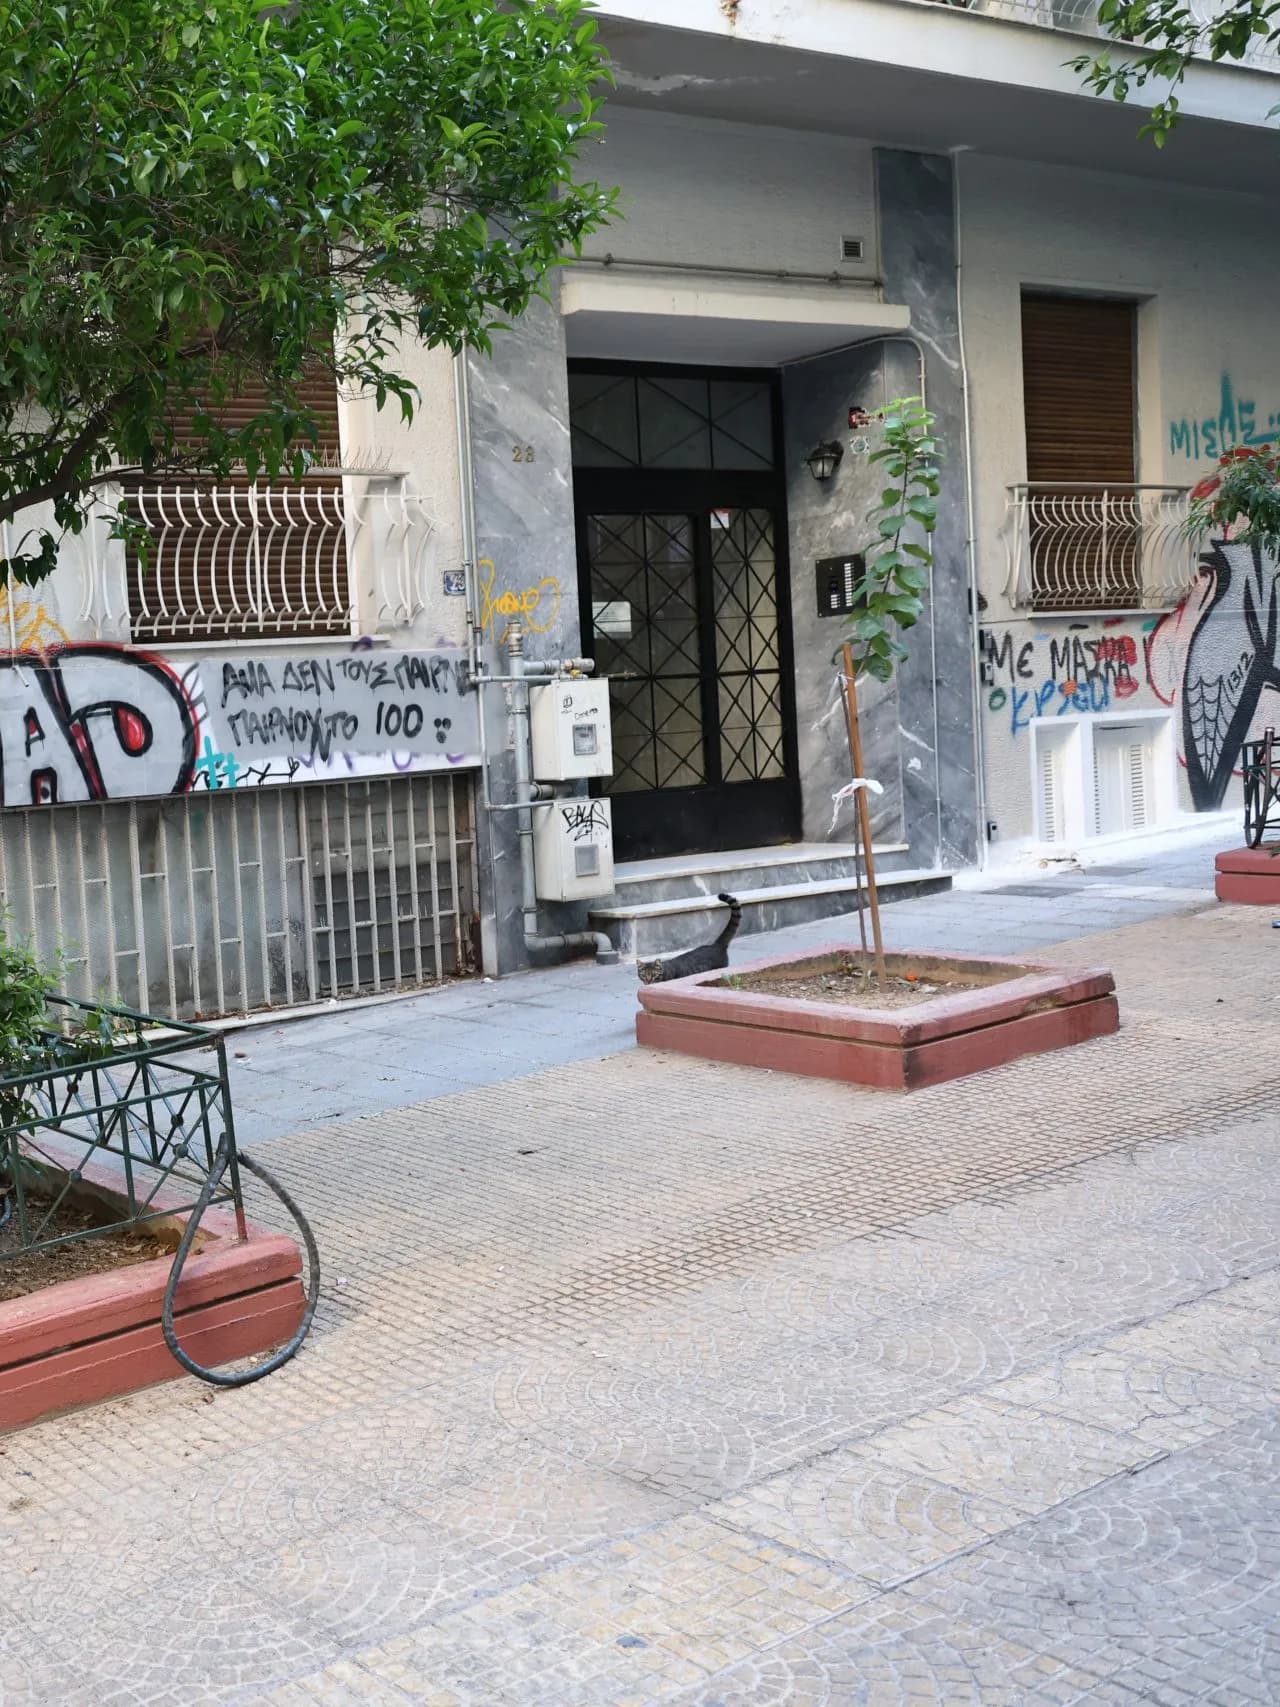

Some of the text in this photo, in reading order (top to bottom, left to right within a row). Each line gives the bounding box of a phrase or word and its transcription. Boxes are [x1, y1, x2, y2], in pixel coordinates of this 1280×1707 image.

[282, 659, 335, 696] ΔΕΝ
[336, 657, 395, 690] ΤΟΥΣ
[376, 702, 424, 738] 100
